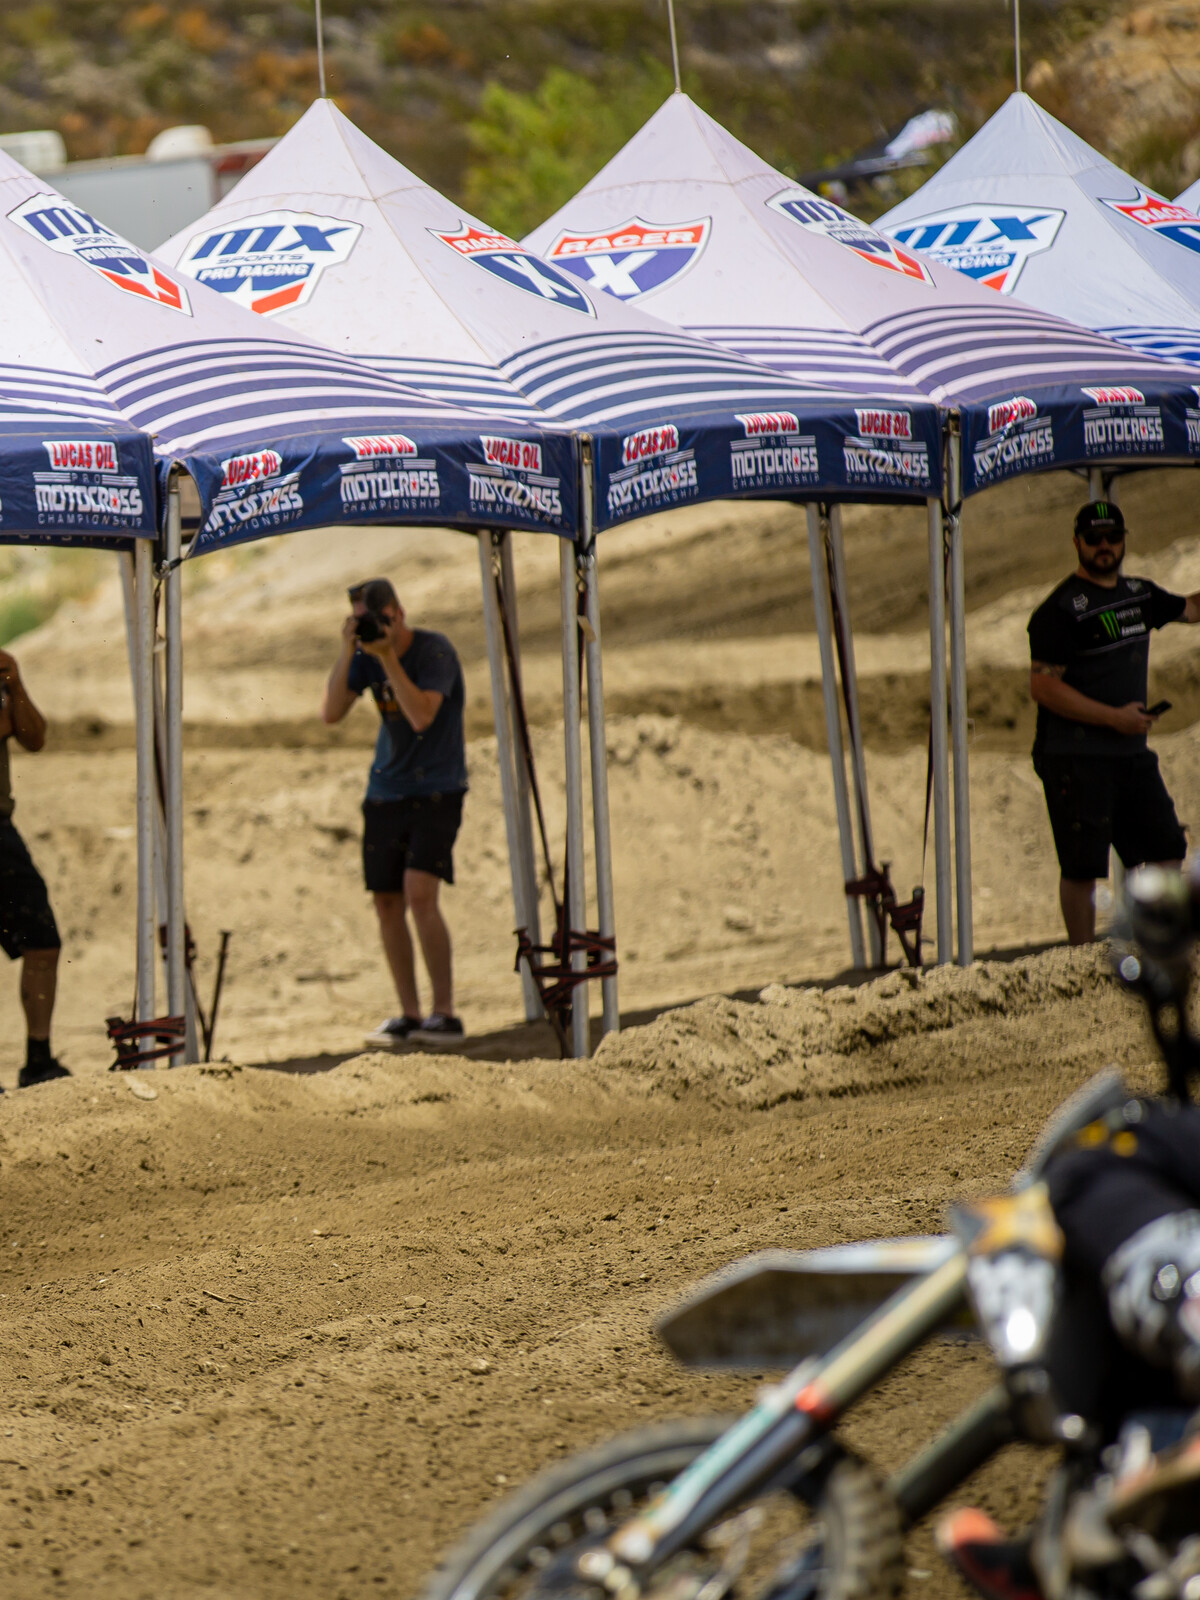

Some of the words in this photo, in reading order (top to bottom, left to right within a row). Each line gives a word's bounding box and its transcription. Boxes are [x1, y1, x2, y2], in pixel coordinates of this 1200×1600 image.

[190, 225, 353, 260] MX
[559, 231, 695, 254] RACER
[199, 266, 237, 281] PRO
[238, 263, 310, 278] RACING
[216, 253, 305, 264] SPORTS
[490, 255, 581, 298] X
[584, 250, 658, 296] X
[746, 414, 779, 434] LUCAS
[780, 414, 797, 431] OIL
[860, 411, 892, 435] LUCAS
[893, 414, 910, 437] OIL
[1083, 417, 1164, 445] MOTOCROSS
[352, 436, 393, 456] LUCAS
[392, 435, 414, 454] OIL
[486, 439, 520, 467] LUCAS
[523, 443, 539, 469] OIL
[626, 434, 658, 461] LUCAS
[659, 429, 677, 452] OIL
[760, 437, 787, 447] PRO
[51, 442, 93, 468] LUCAS
[95, 443, 117, 470] OIL
[374, 459, 402, 470] PRO
[730, 447, 819, 478] MOTOCROSS
[71, 473, 102, 485] PRO
[340, 470, 441, 503] MOTOCROSS
[607, 459, 698, 511] MOTOCROSS
[732, 473, 820, 490] CHAMPIONSHIP
[34, 484, 144, 516] MOTOCROSS
[342, 498, 441, 514] CHAMPIONSHIP
